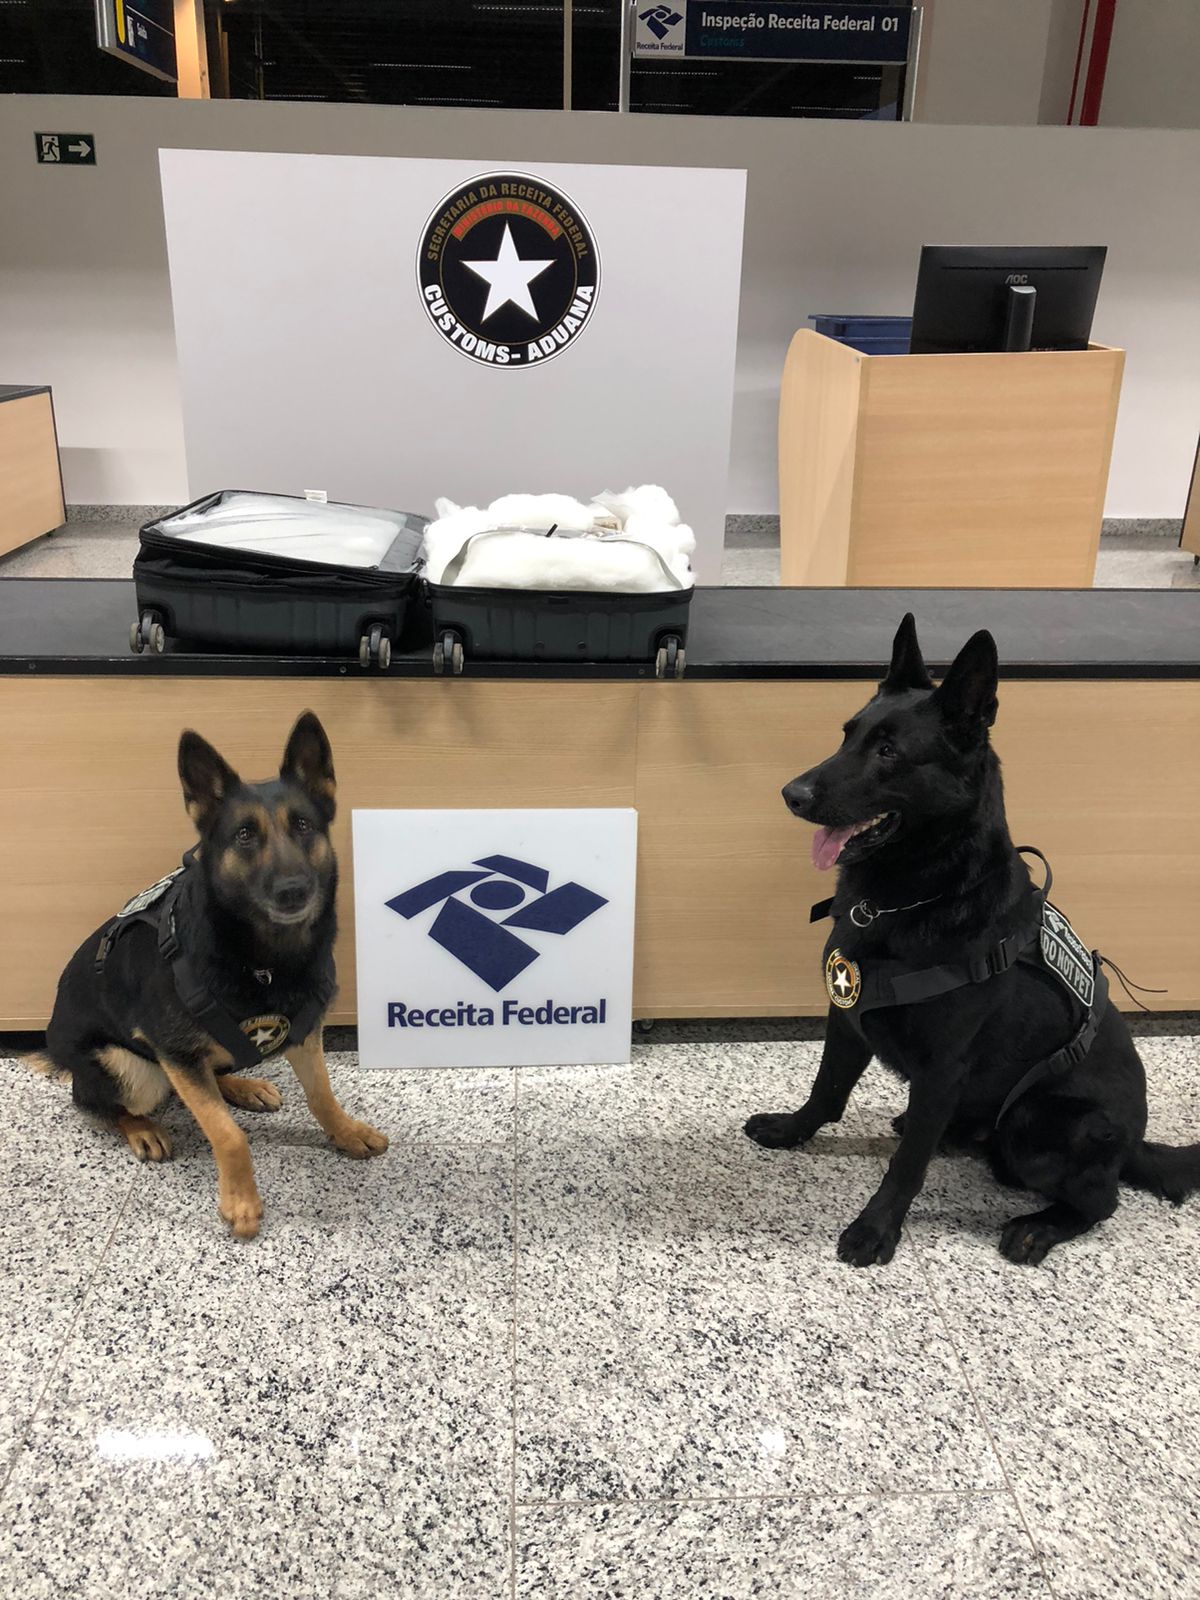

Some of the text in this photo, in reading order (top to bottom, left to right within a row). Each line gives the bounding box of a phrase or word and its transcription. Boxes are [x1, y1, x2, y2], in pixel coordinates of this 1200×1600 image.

[701, 12, 899, 32] Inspeção Receita Federal 01
[636, 42, 684, 51] Receita Federal
[427, 183, 588, 261] SECRETARIA DA RECEITA FEDERAL
[1005, 274, 1028, 284] AOC
[528, 285, 595, 361] ADUANA
[1042, 933, 1057, 961] DO
[1057, 947, 1075, 981] NOT
[1074, 966, 1091, 998] PET
[387, 998, 606, 1028] Receita Federal
